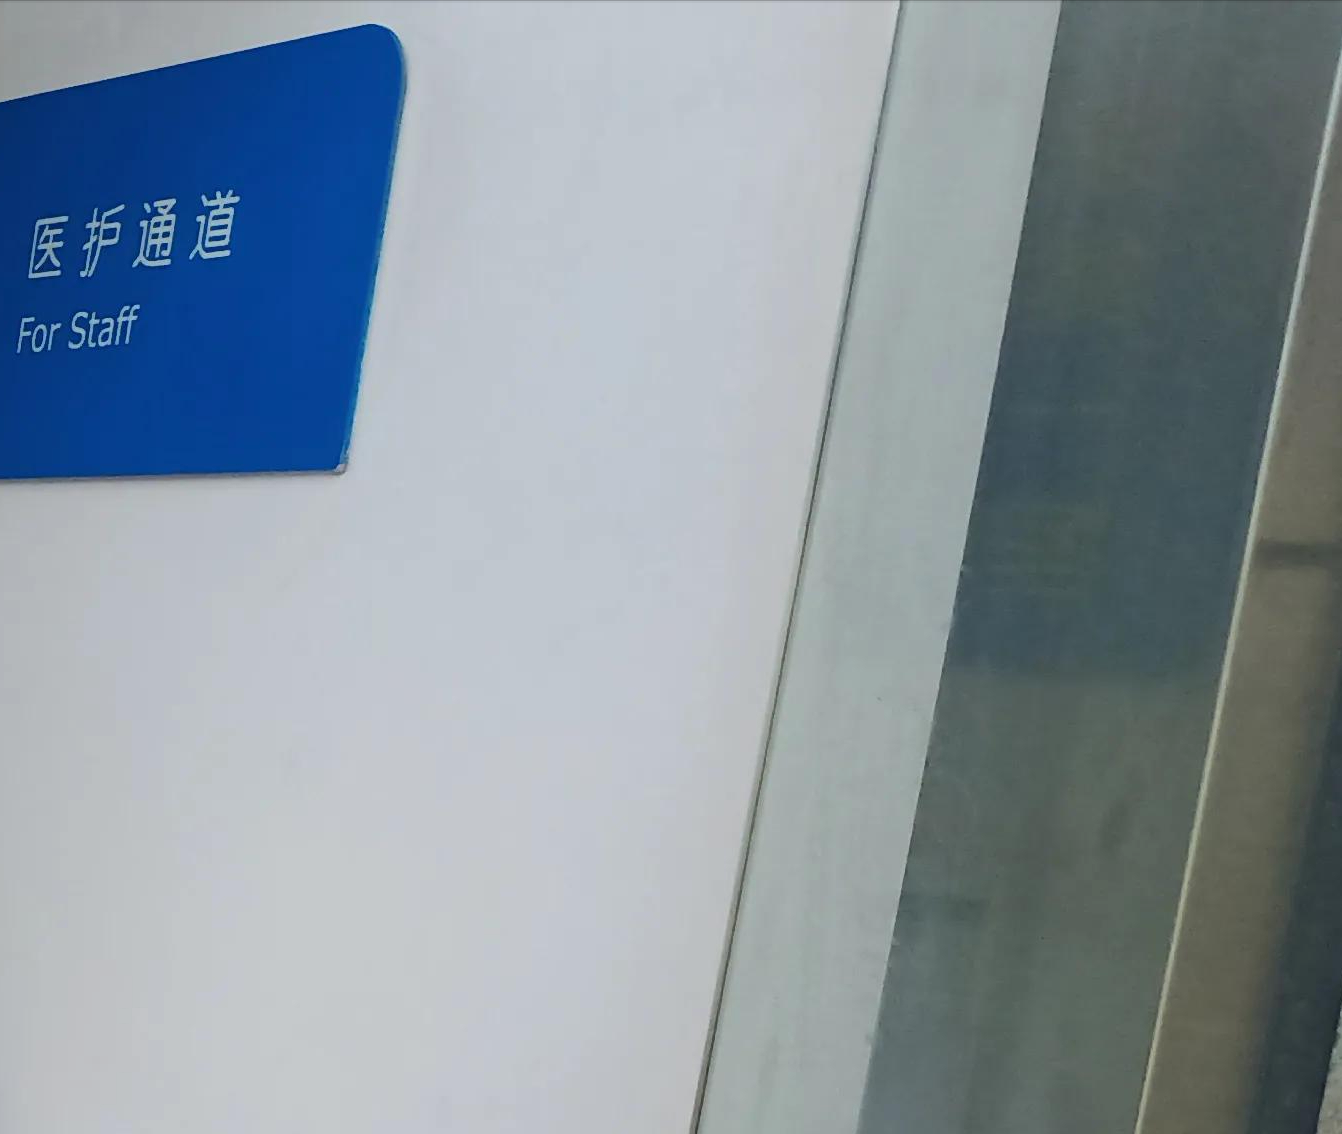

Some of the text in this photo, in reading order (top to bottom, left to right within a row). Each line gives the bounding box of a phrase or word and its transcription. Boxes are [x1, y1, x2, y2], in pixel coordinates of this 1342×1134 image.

[27, 189, 241, 279] 医护通道
[16, 304, 141, 354] For Staff
